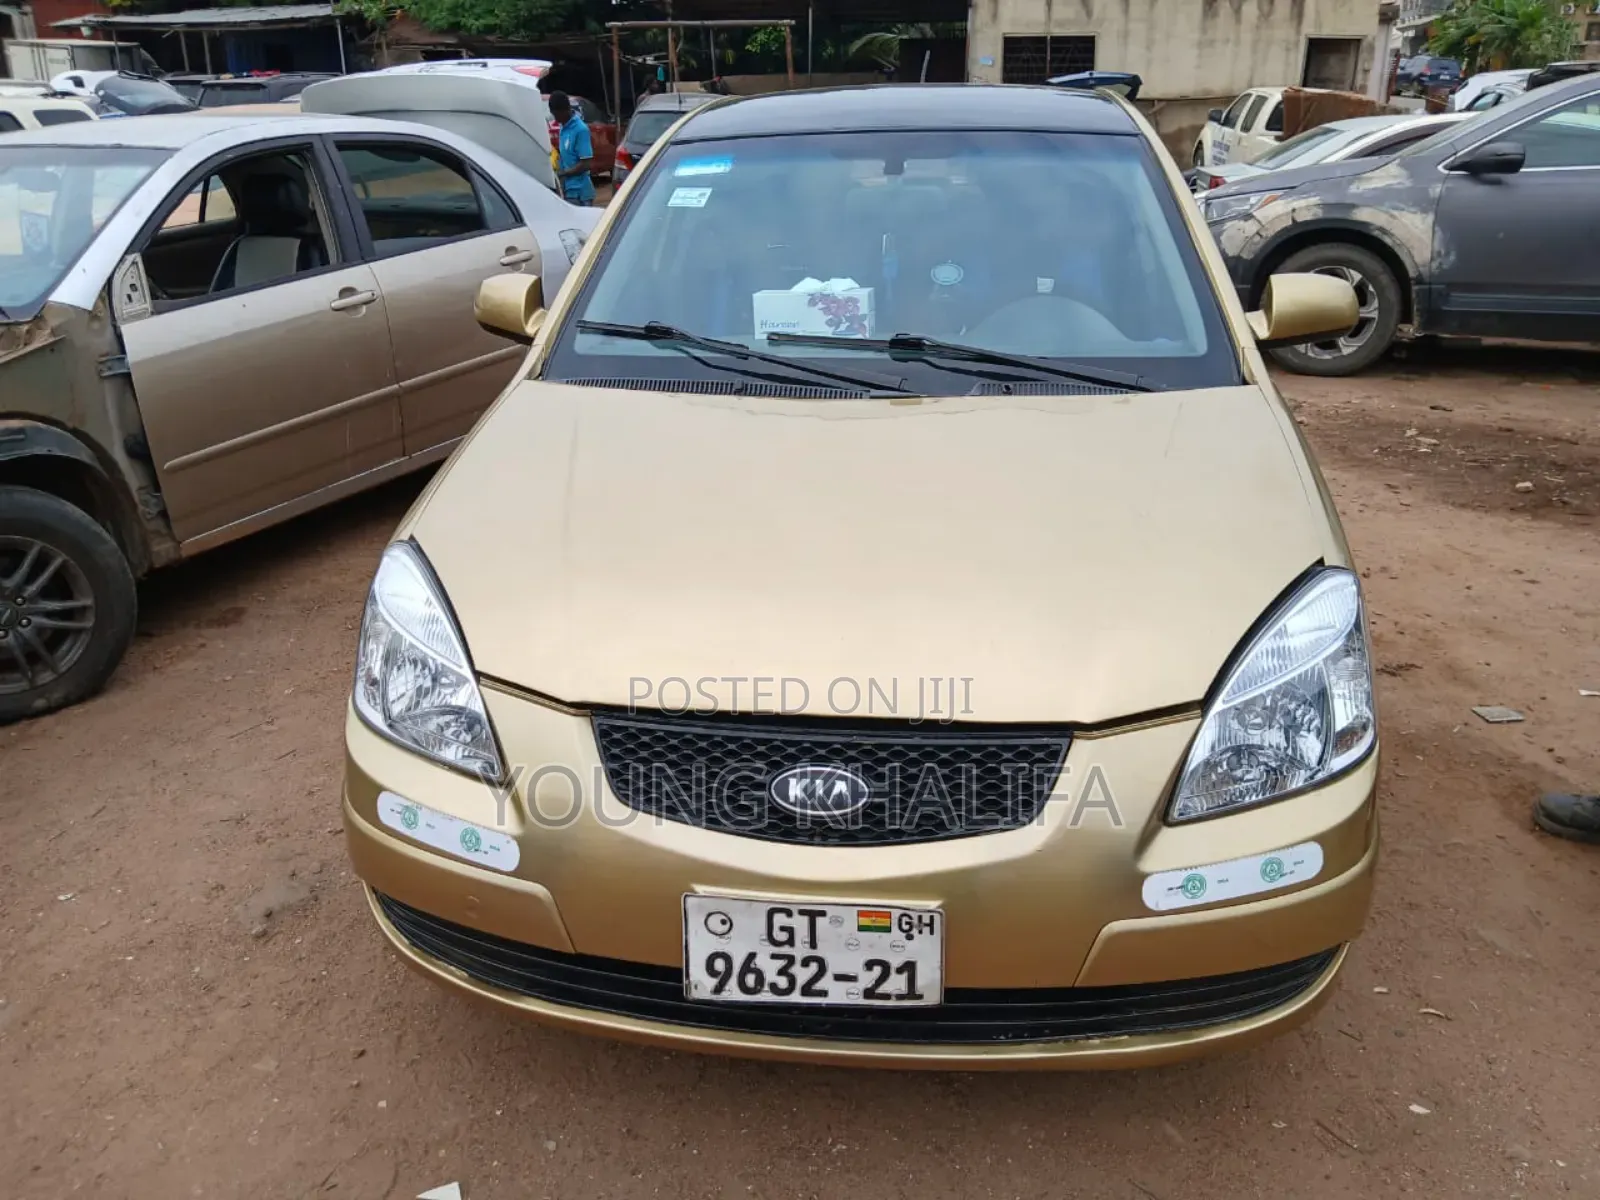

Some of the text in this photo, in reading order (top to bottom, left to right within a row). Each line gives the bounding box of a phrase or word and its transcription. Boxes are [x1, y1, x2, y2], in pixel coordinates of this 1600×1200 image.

[788, 777, 852, 805] KIA
[766, 906, 828, 950] GT
[897, 913, 935, 936] GH
[705, 951, 924, 1001] 9632-21
